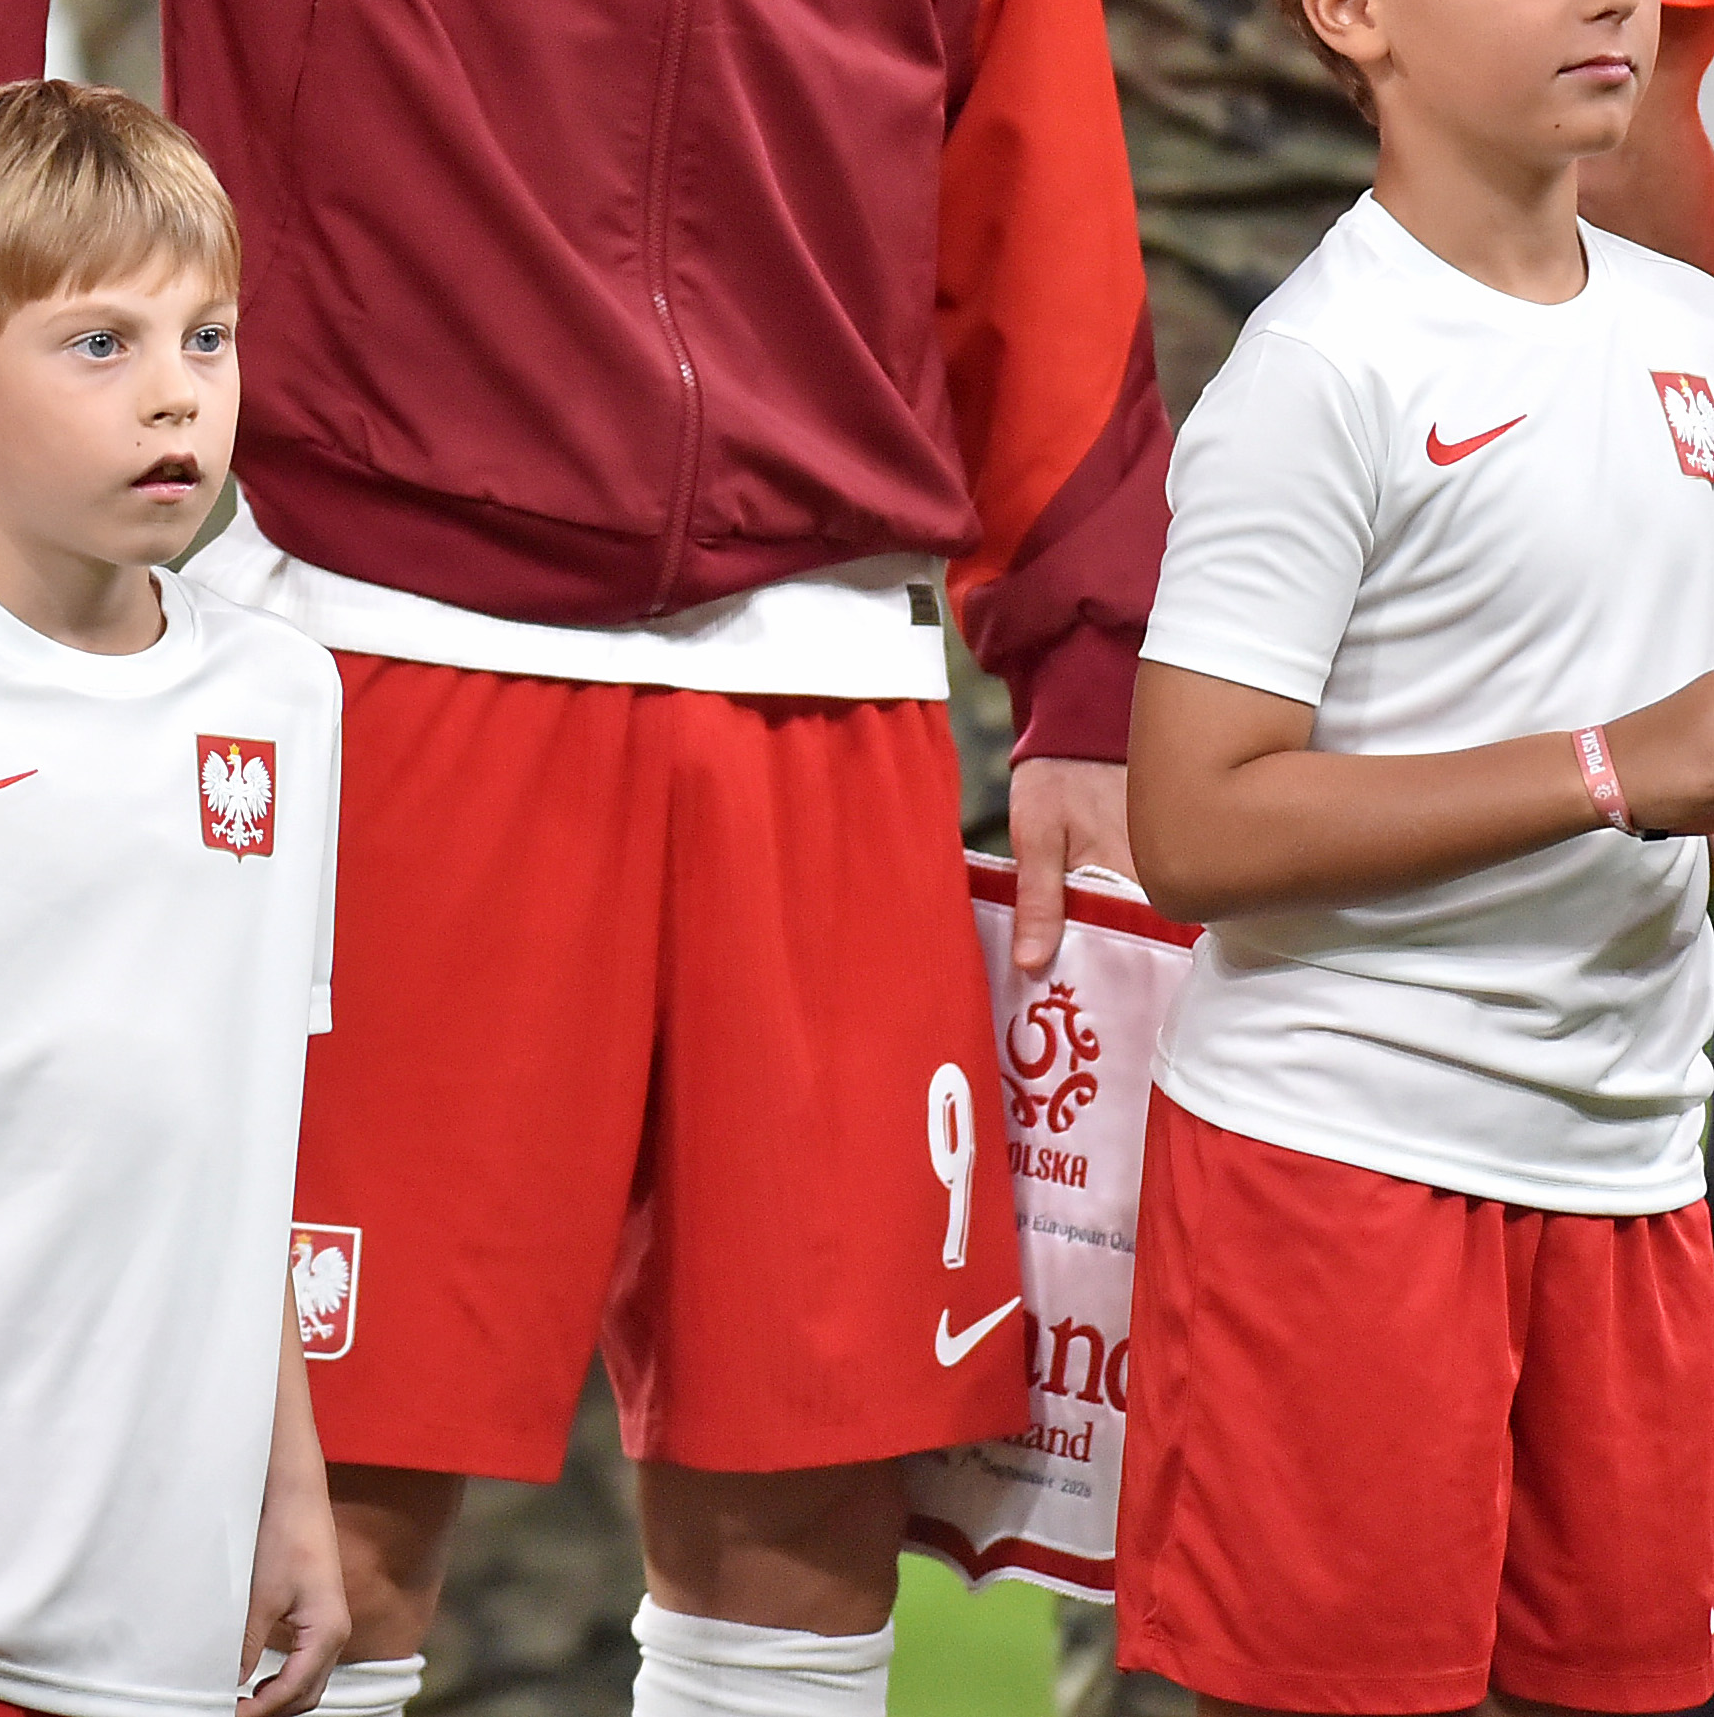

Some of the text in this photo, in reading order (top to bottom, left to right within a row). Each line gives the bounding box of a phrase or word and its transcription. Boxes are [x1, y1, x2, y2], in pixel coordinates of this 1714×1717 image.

[1580, 730, 1606, 775] POLSKA
[927, 1062, 976, 1270] 9
[1008, 1141, 1089, 1189] OLSKA
